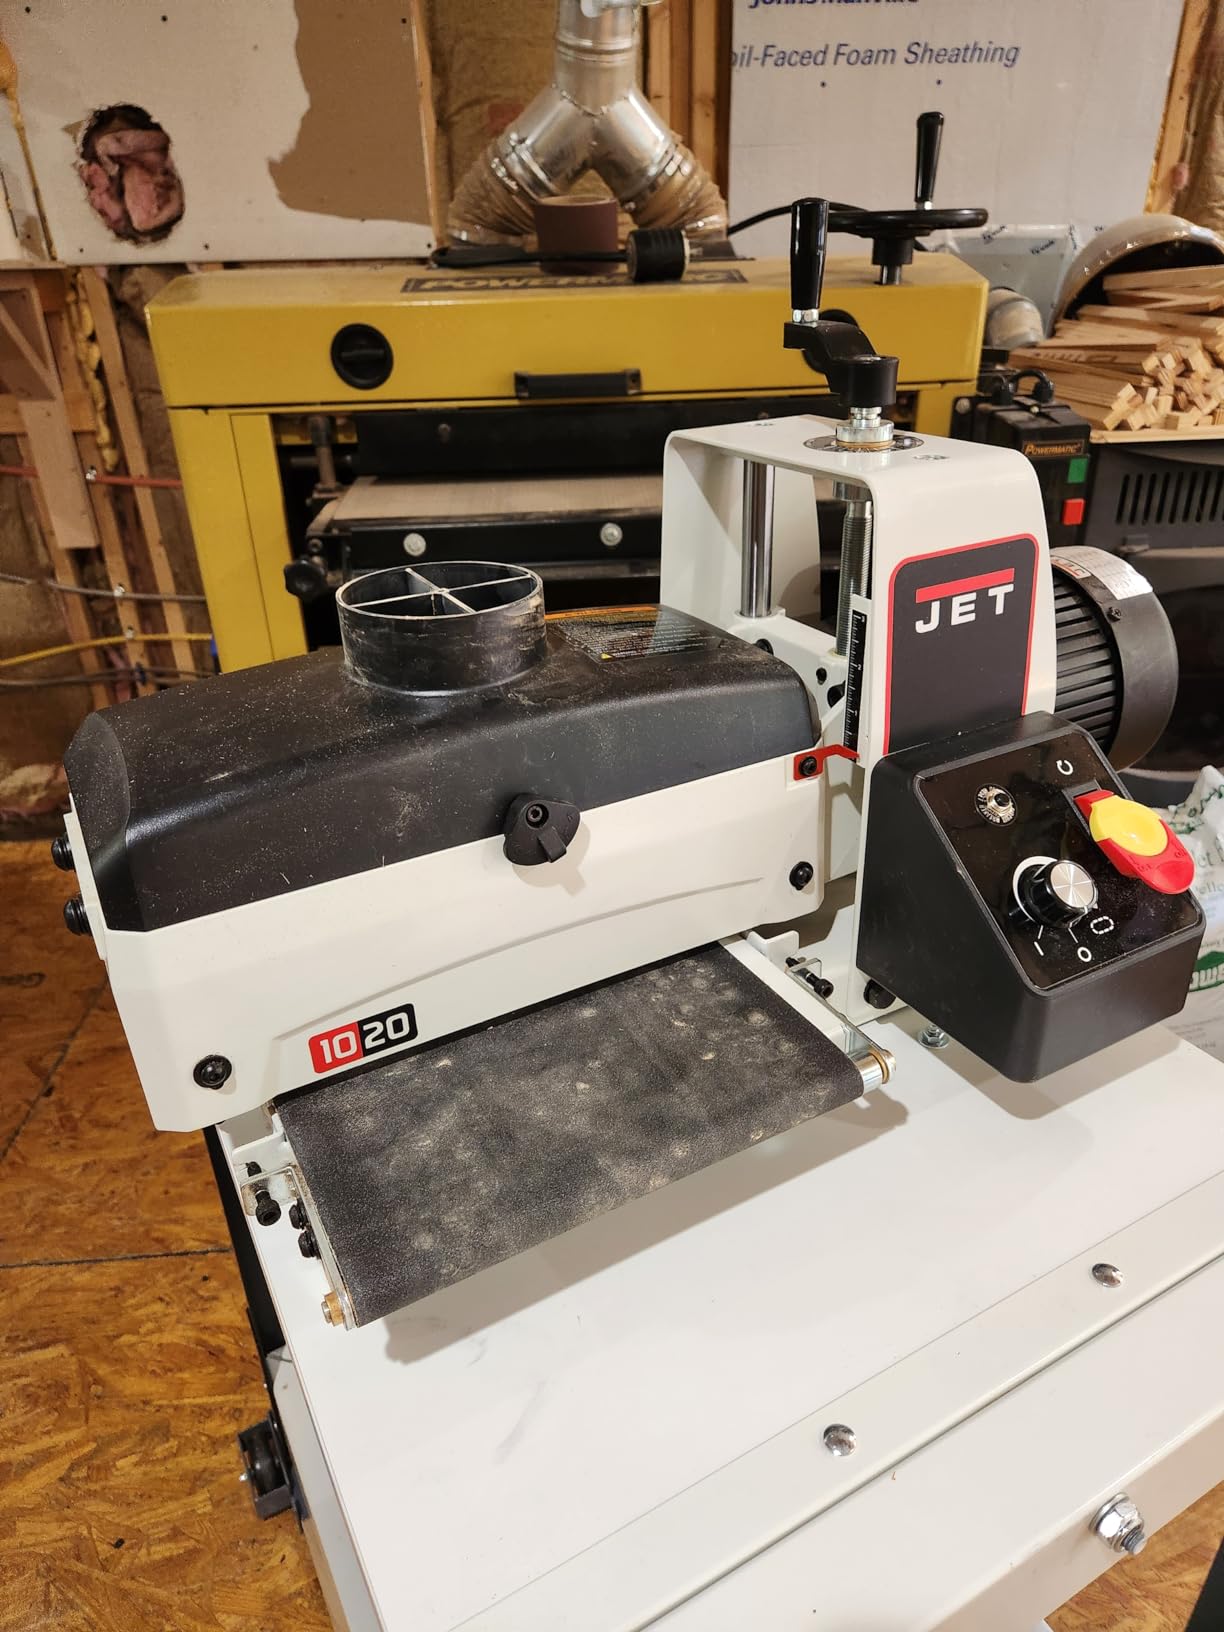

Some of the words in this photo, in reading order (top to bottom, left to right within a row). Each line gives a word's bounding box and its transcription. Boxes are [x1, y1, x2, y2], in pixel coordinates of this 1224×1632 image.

[731, 43, 829, 67] oil-Faced
[833, 43, 897, 66] Foam
[904, 40, 1021, 68] Sheathing
[915, 583, 1015, 634] JET
[320, 1012, 410, 1064] 1020
